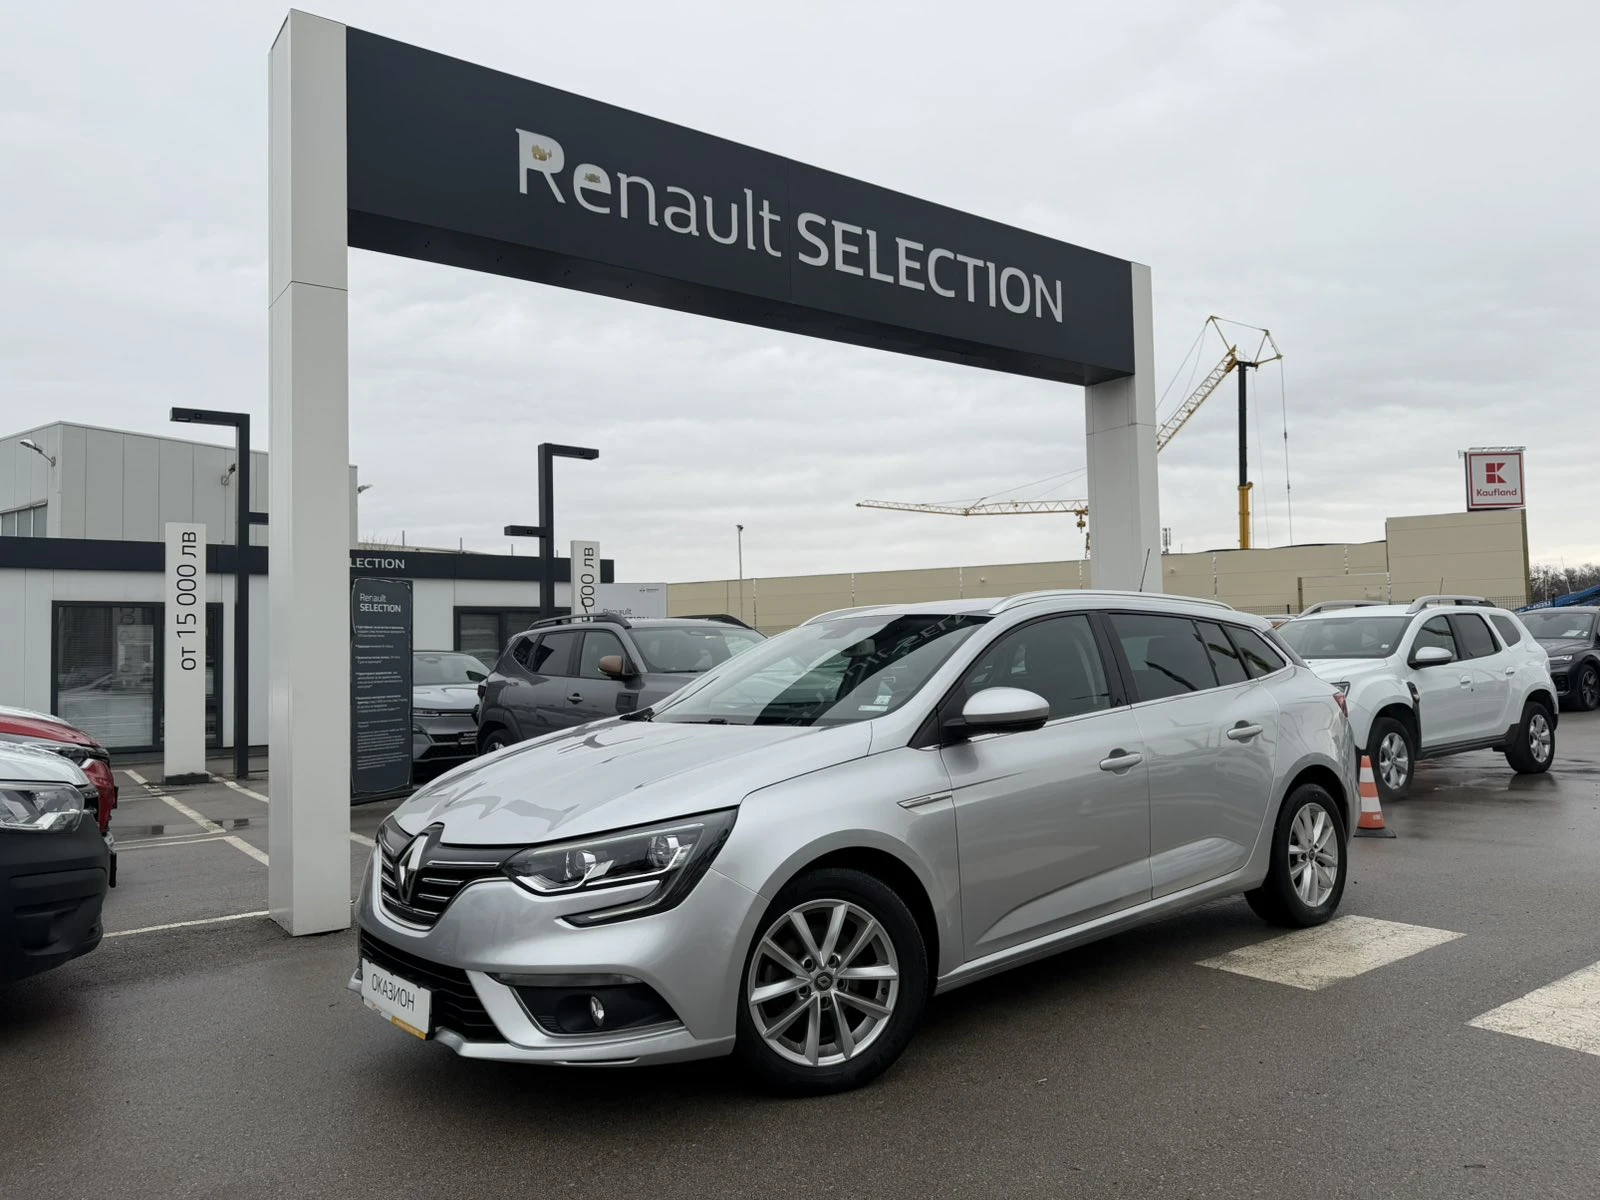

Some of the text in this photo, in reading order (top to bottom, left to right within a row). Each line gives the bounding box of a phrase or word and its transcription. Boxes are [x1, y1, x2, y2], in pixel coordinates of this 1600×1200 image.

[515, 128, 1063, 323] Renault SELECTION
[1476, 488, 1517, 497] Kaufland
[176, 564, 197, 606] 000
[360, 593, 387, 602] Renault
[359, 603, 402, 613] SELECTION
[176, 613, 197, 638] 15
[371, 973, 415, 1012] ОКАЗИОН
